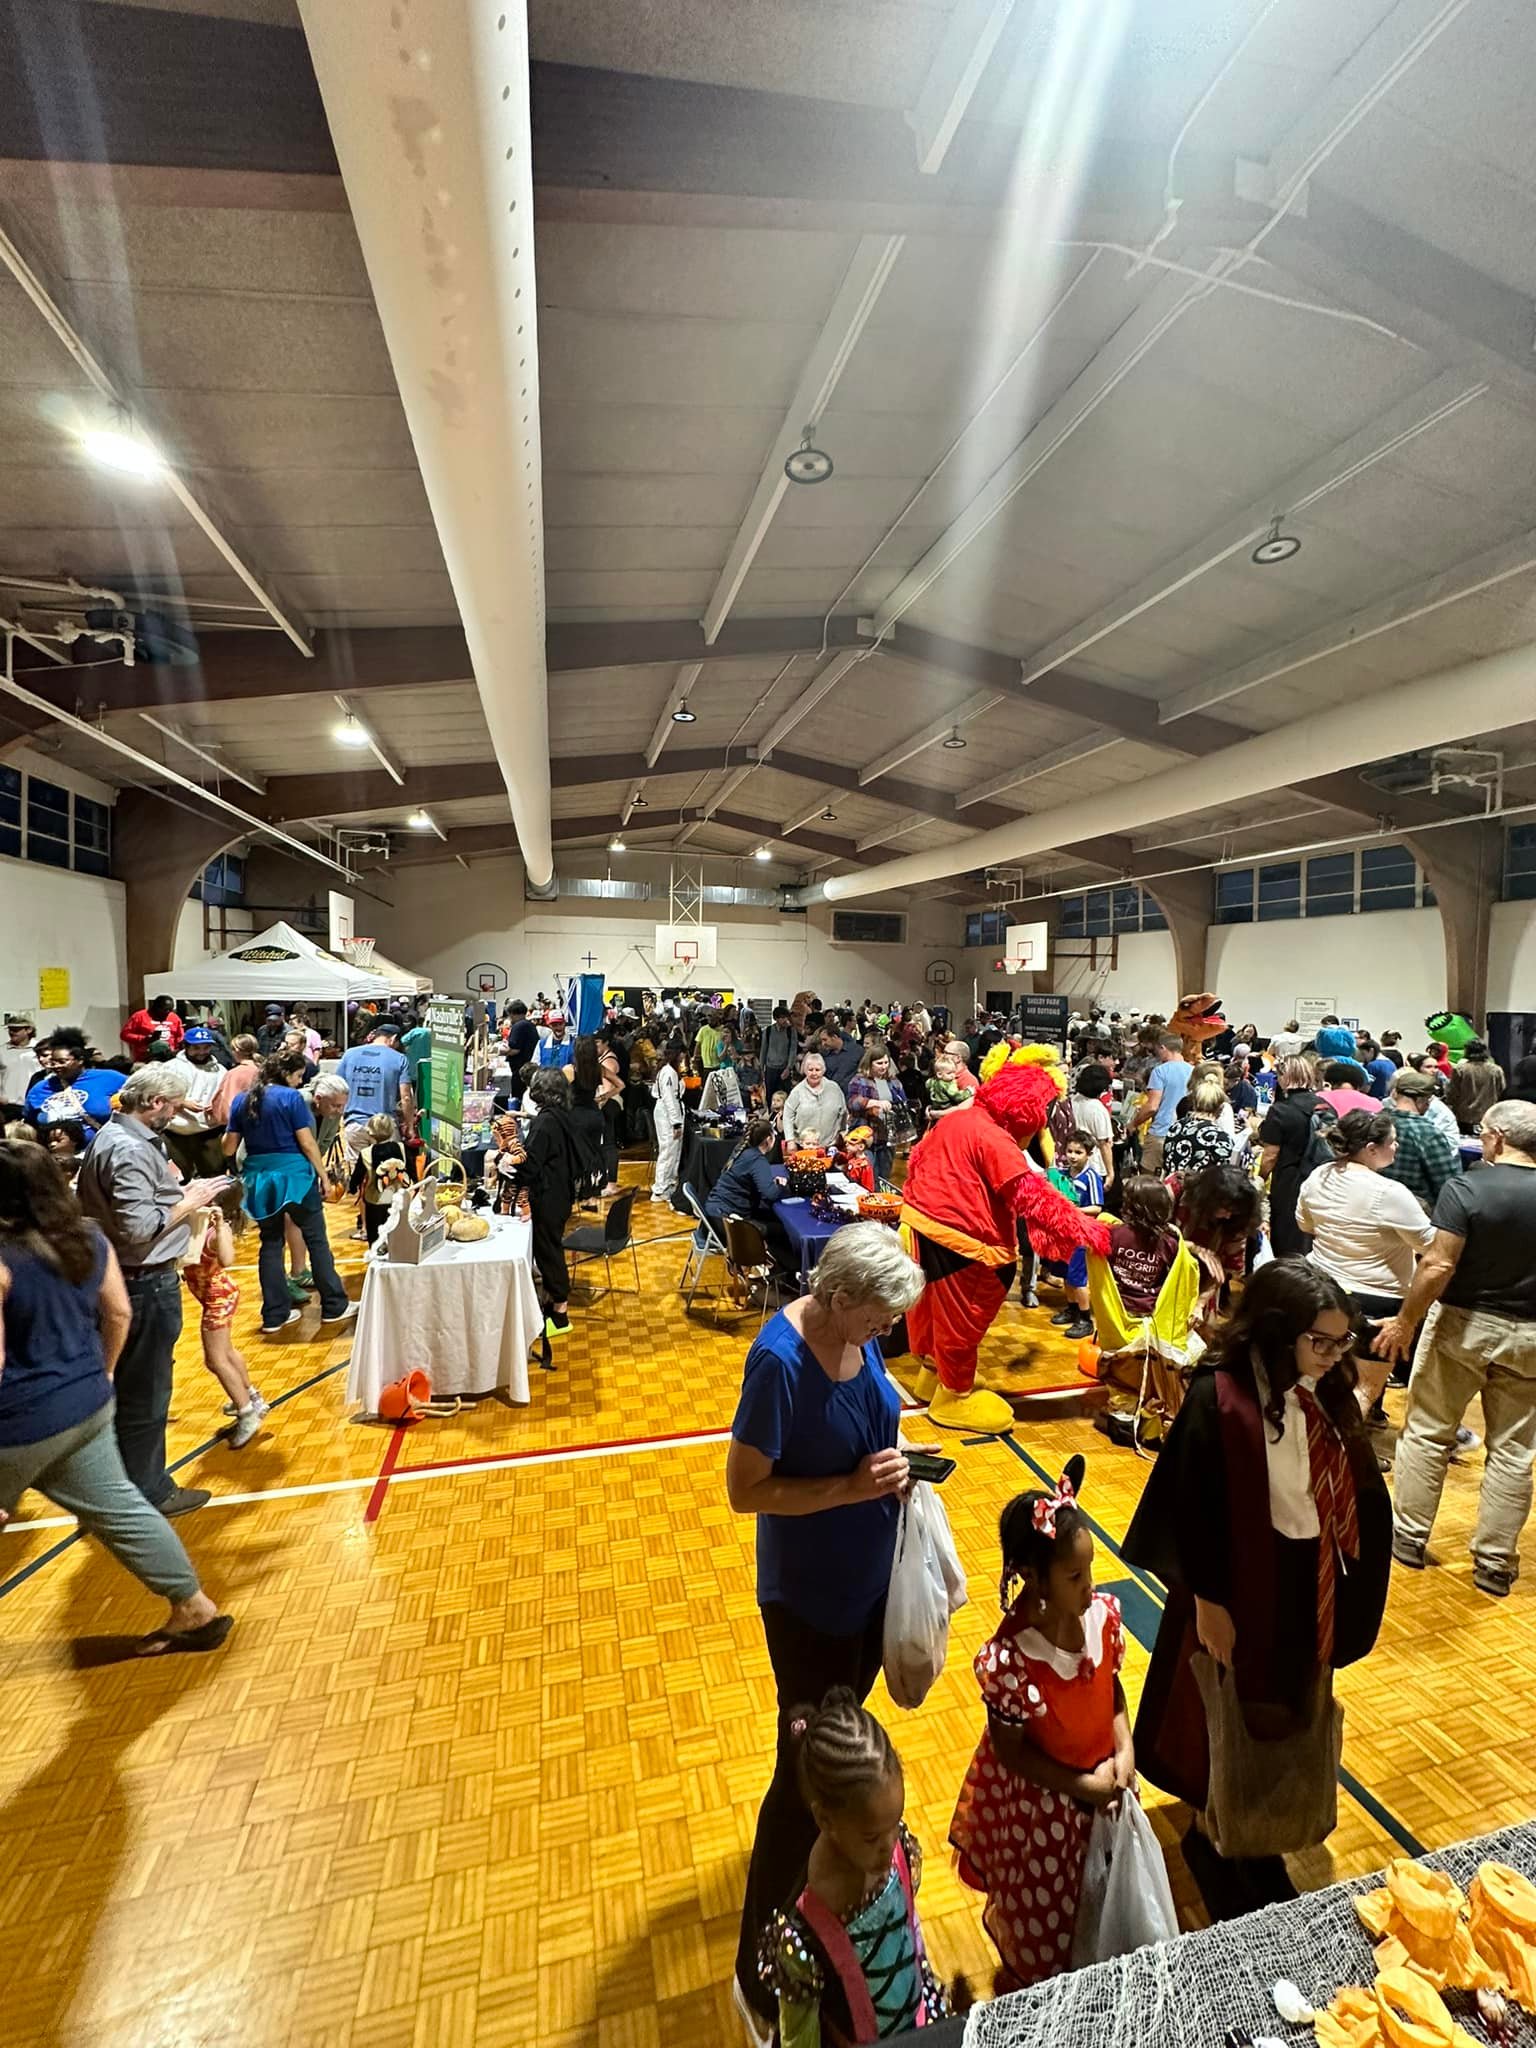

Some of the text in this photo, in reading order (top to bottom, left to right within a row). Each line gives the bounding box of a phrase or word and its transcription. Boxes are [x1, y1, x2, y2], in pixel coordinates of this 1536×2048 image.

[1046, 998, 1060, 1006] PARK
[195, 1031, 209, 1039] 42
[353, 1065, 381, 1075] HOKA
